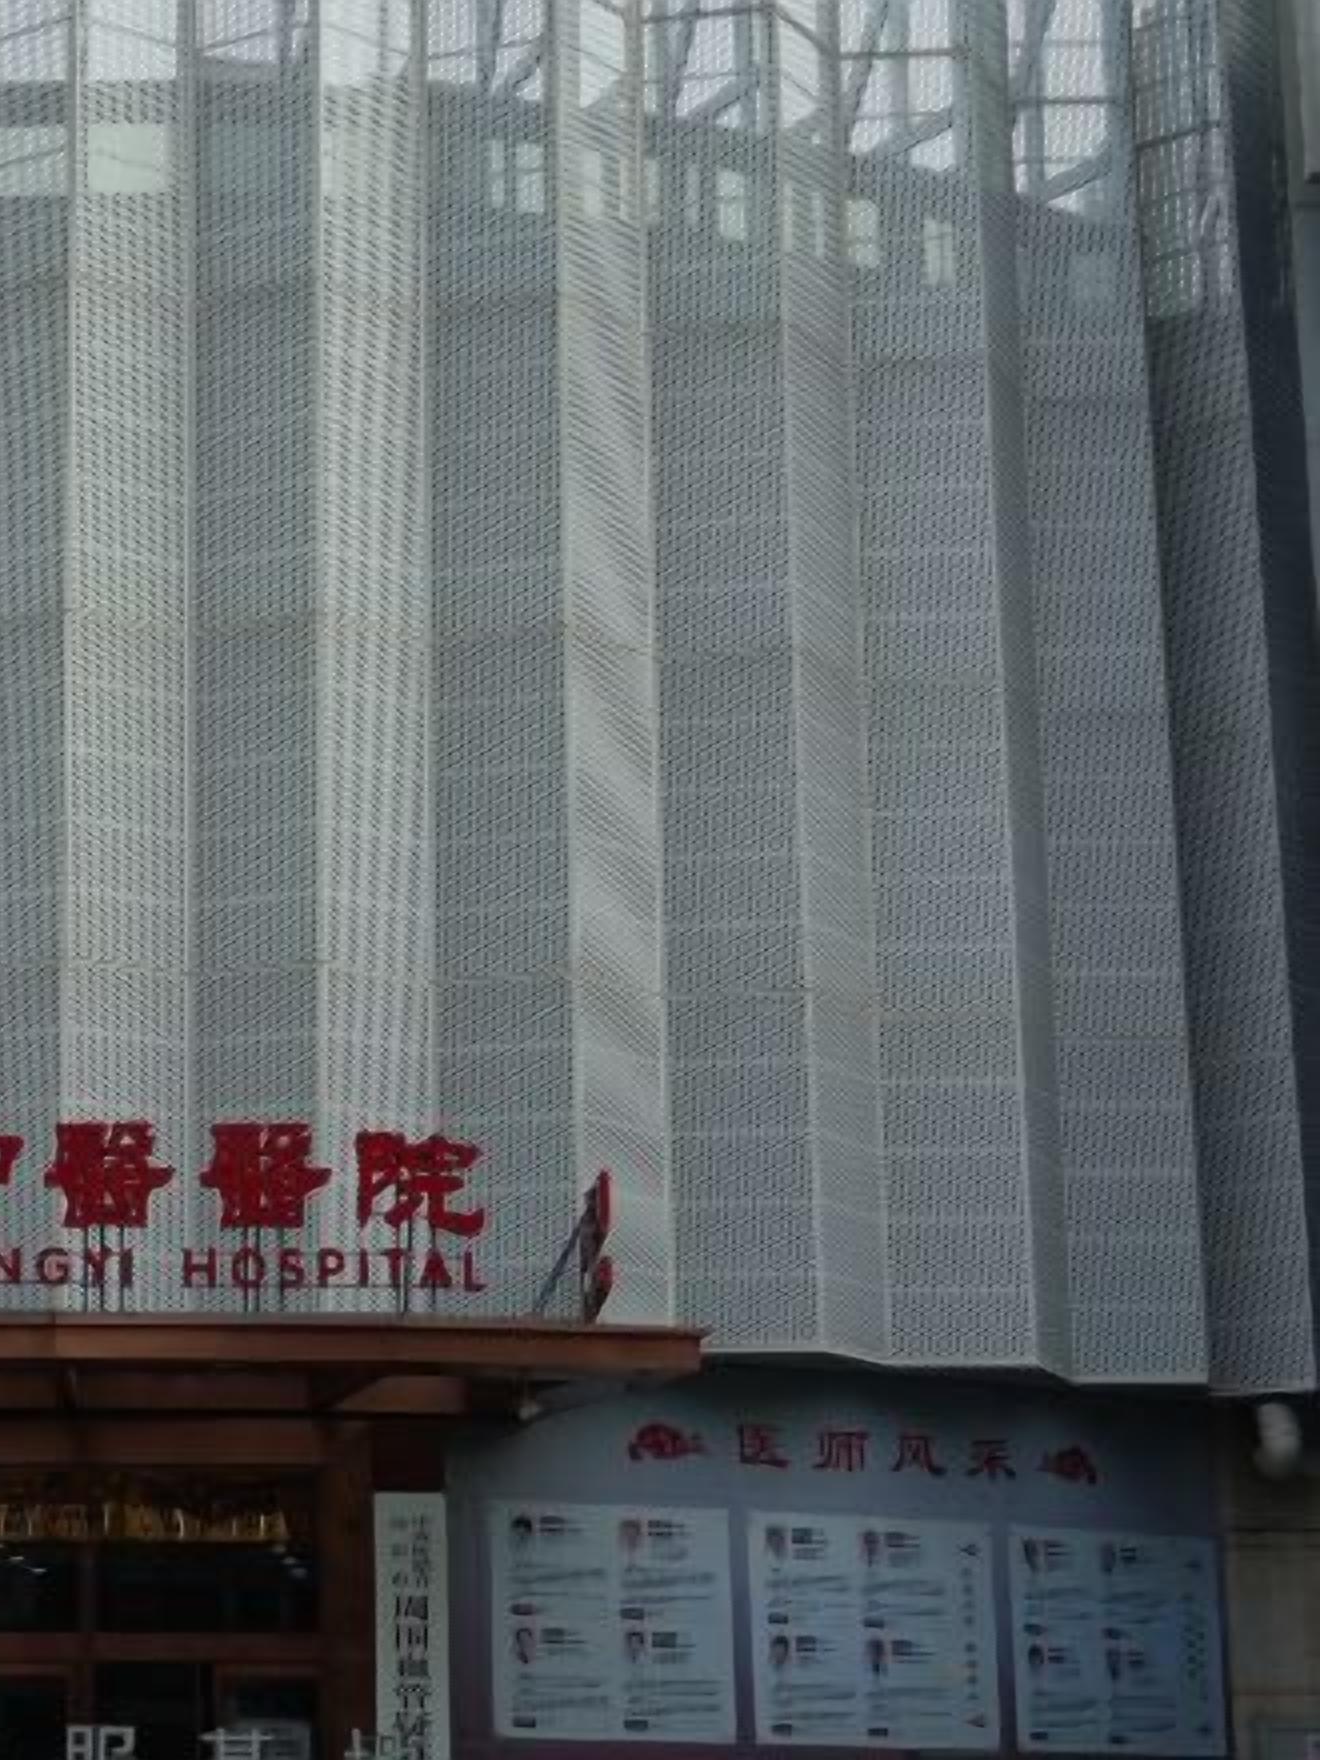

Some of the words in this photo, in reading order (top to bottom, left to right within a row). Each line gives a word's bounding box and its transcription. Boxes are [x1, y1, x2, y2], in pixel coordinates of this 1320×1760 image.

[184, 1247, 488, 1292] HOSPITAL
[738, 1422, 1016, 1481] 医师风采
